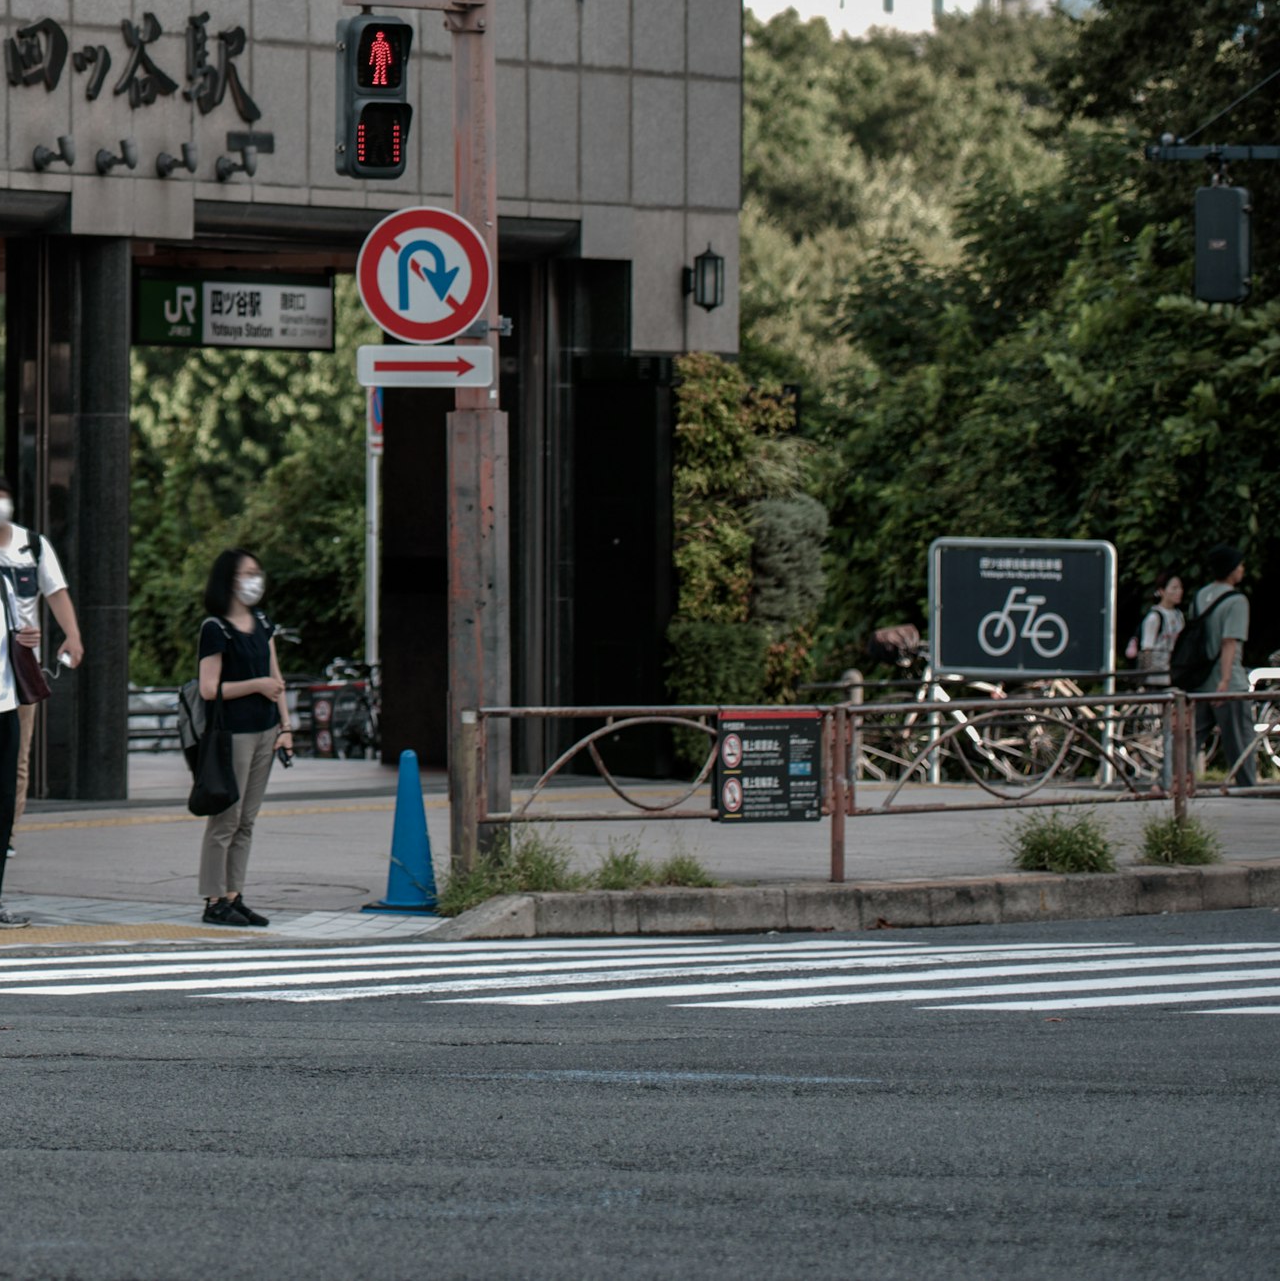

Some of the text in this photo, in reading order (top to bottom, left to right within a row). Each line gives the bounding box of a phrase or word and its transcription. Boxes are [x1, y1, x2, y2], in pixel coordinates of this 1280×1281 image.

[164, 286, 196, 324] JR
[211, 290, 261, 317] 四ツ谷駅
[211, 322, 243, 340] Yotsuya
[244, 323, 273, 338] Station
